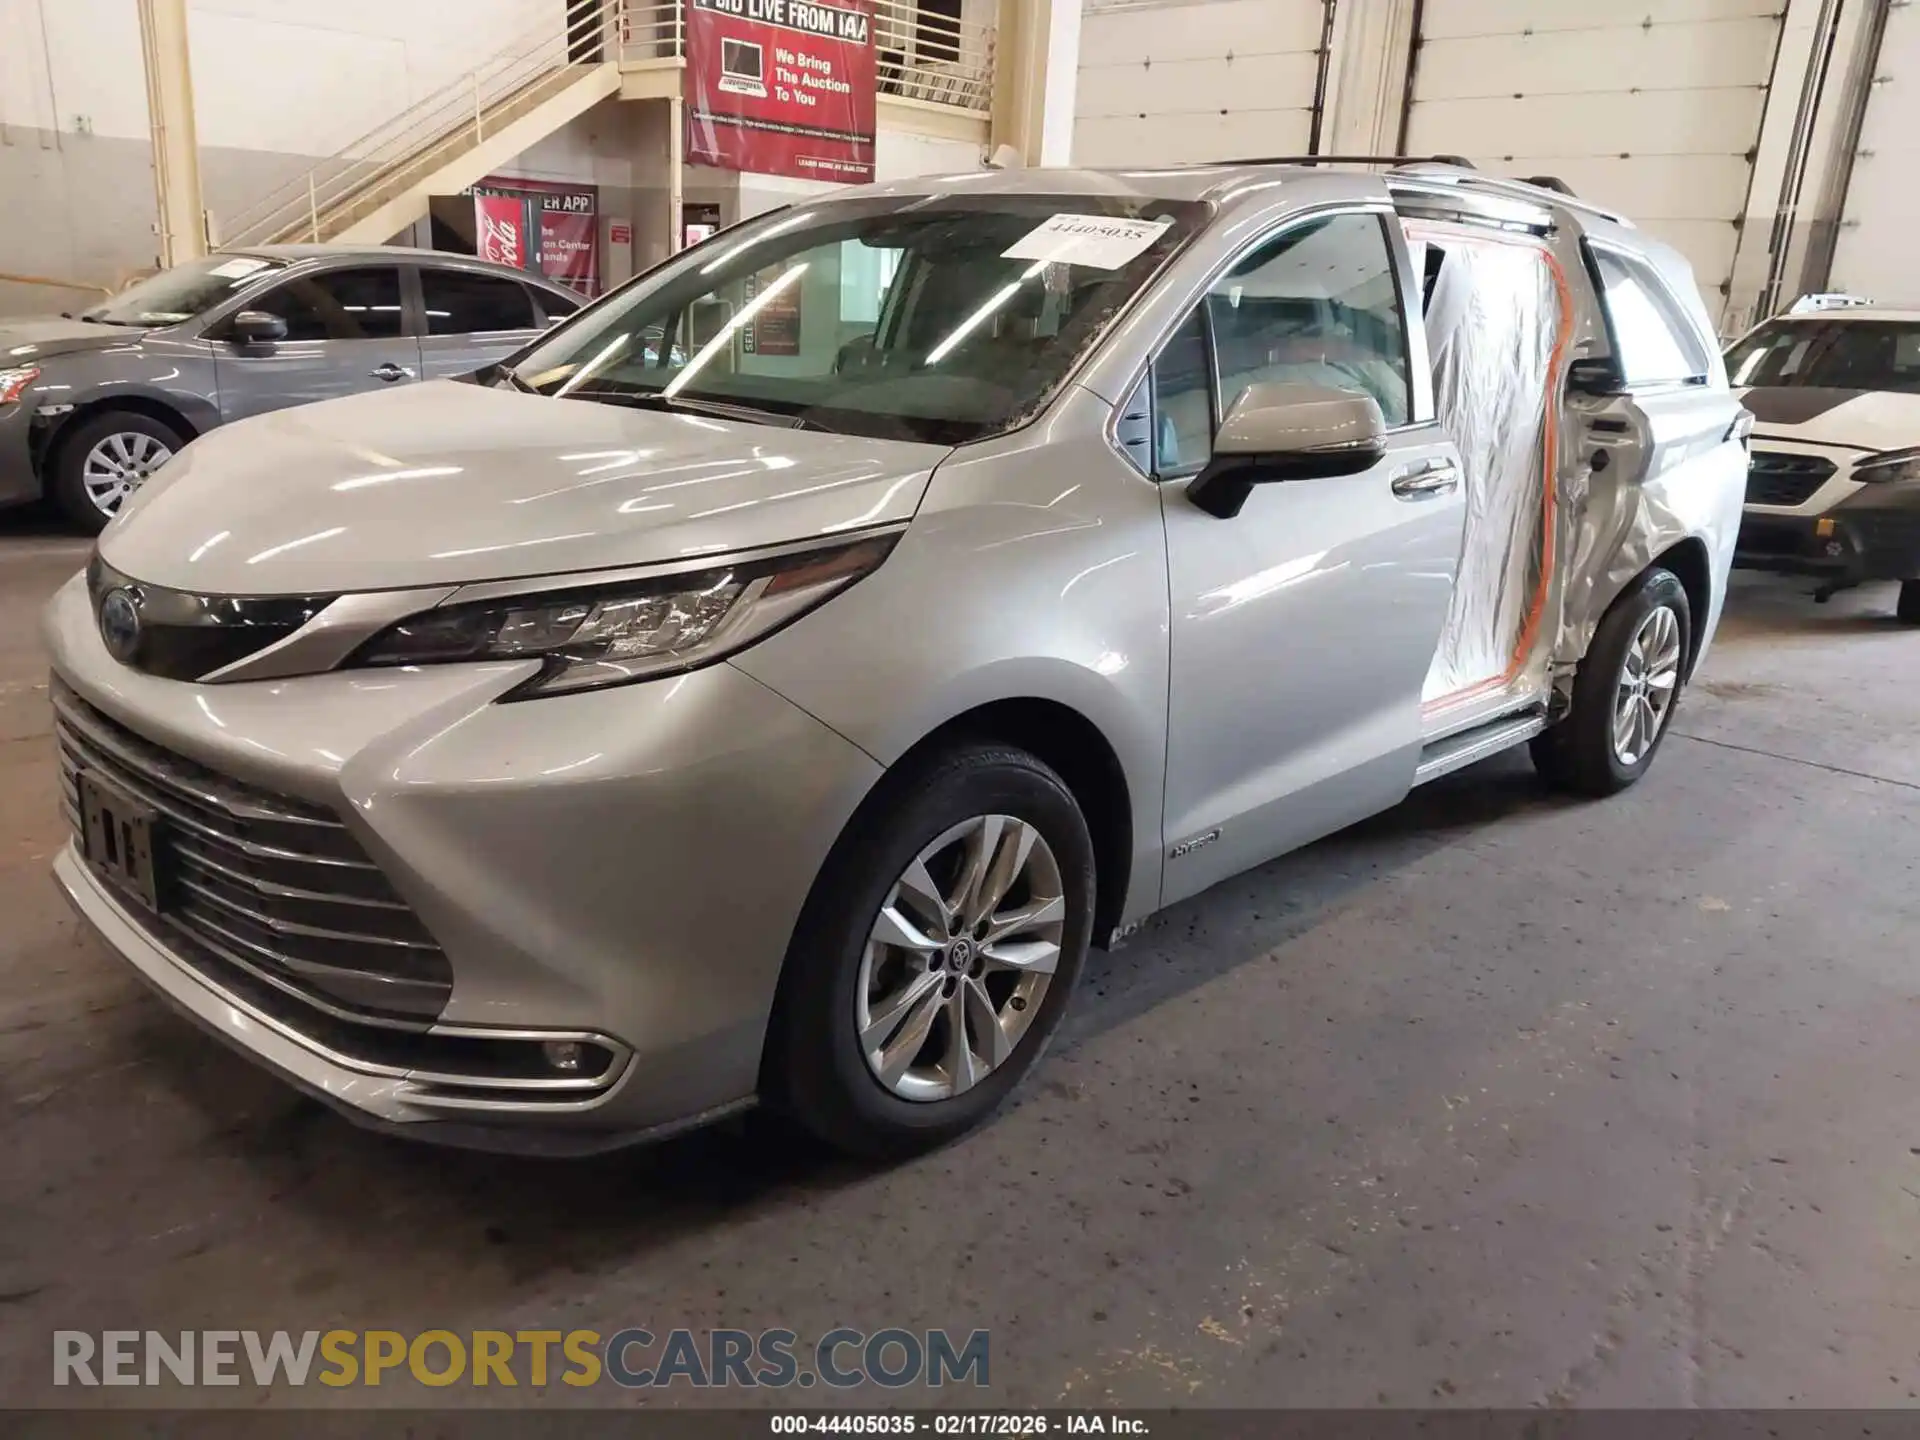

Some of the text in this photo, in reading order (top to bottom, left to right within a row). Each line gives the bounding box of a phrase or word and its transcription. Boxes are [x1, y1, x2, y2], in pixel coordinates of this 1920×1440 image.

[749, 0, 784, 22] LIVE
[788, 3, 834, 33] FROM
[839, 11, 868, 39] IAA
[775, 48, 831, 75] We Bring
[775, 66, 850, 93] The Auction
[774, 86, 816, 105] To You
[544, 196, 589, 211] ER APP
[543, 239, 591, 250] on Center
[543, 252, 568, 262] ands
